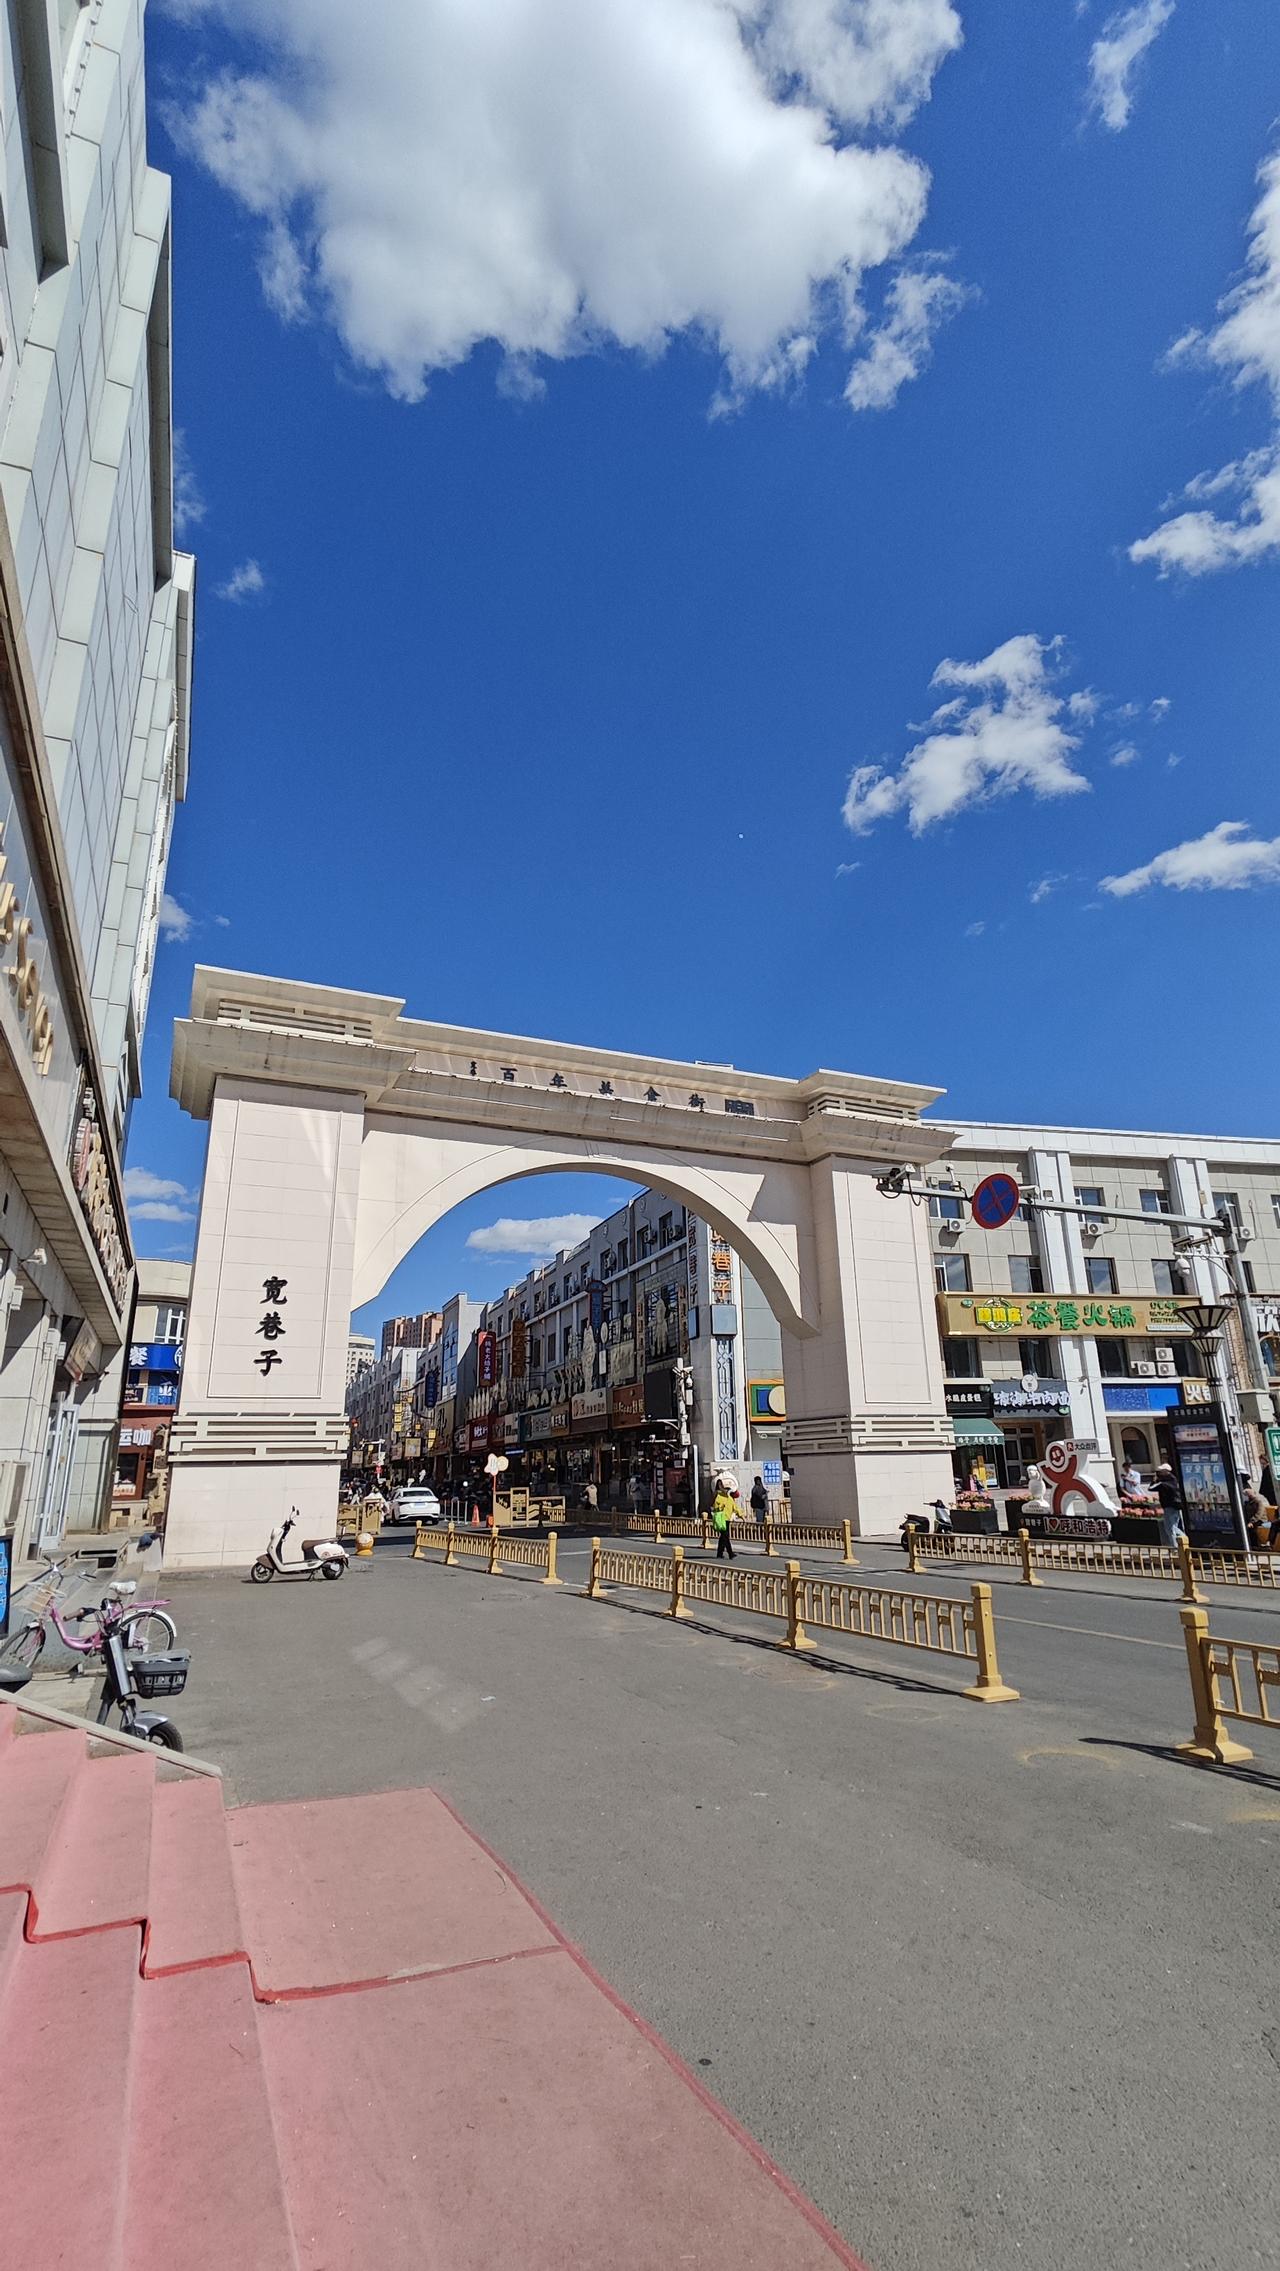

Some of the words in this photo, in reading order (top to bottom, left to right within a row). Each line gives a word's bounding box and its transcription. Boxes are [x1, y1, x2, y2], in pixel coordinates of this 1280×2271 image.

[253, 1276, 288, 1376] 宽巷子
[1026, 1301, 1136, 1330] 茶餐火锅
[129, 1346, 149, 1366] 餐
[1060, 1519, 1109, 1535] 呼和浩特
